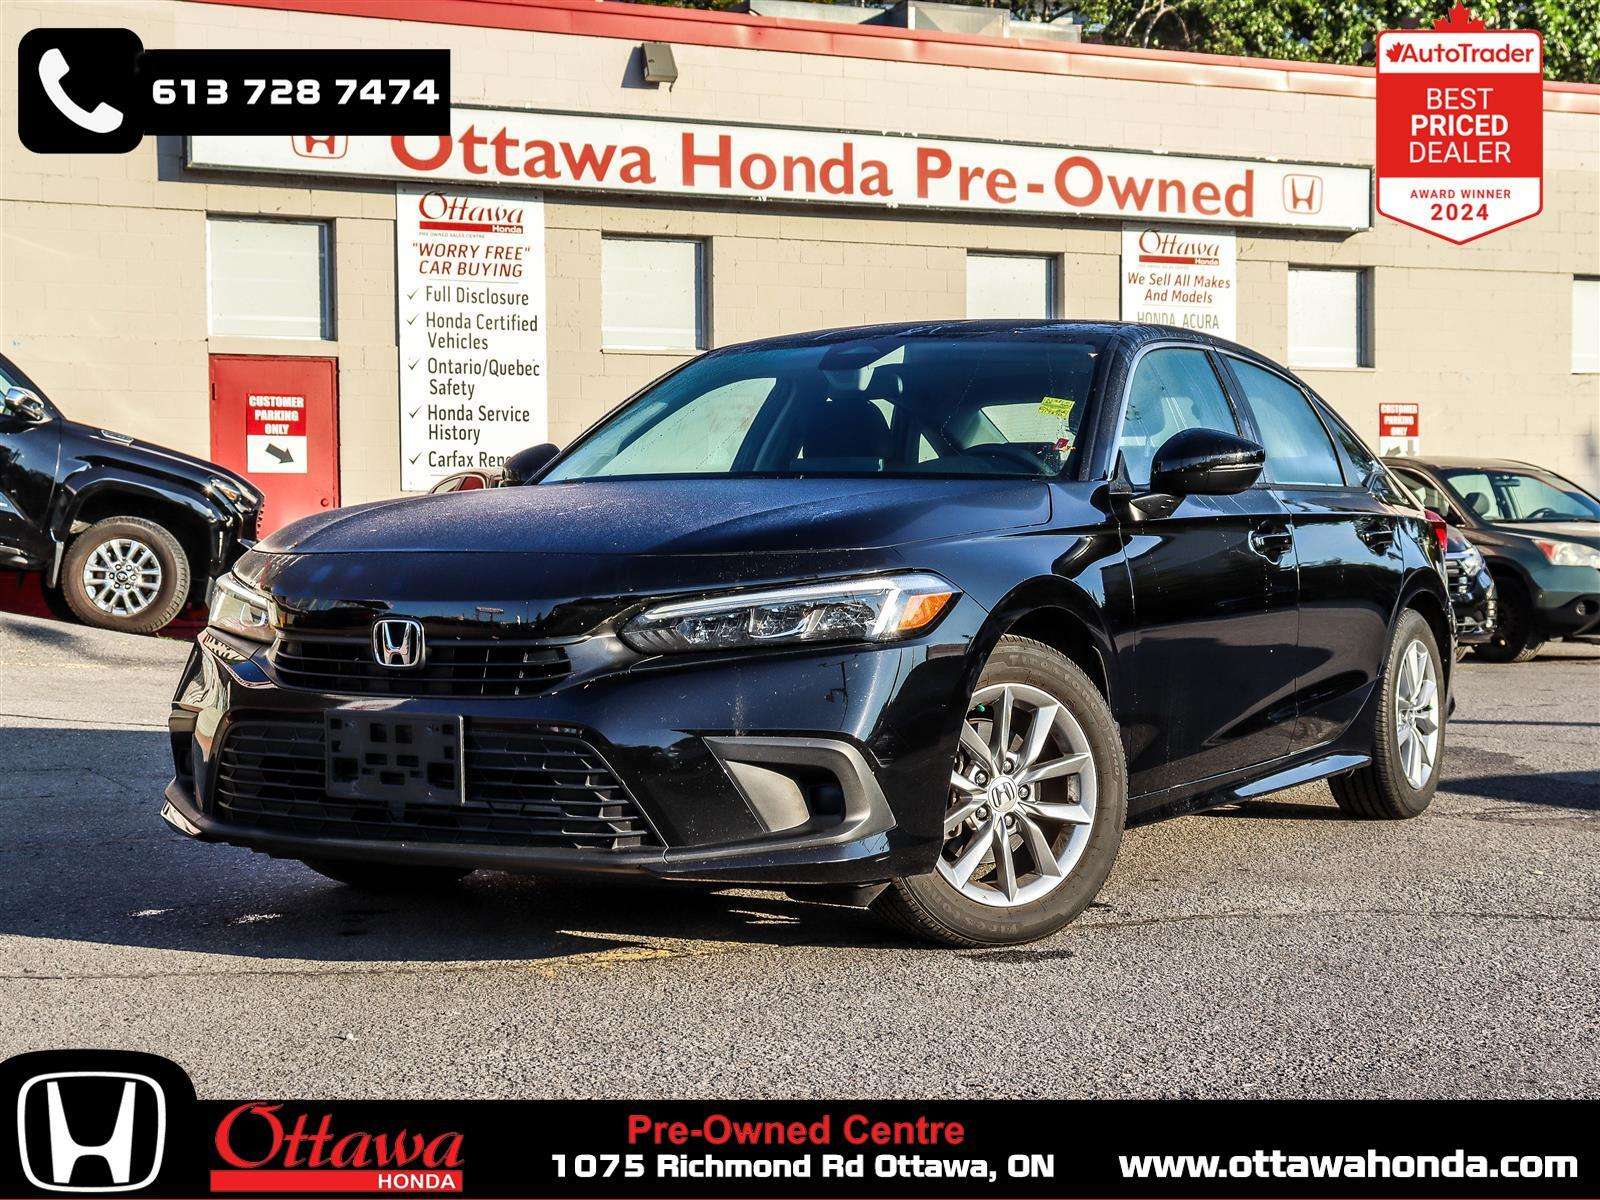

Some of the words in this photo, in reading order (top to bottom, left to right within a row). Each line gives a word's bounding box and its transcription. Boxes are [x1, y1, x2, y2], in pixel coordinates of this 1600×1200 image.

[390, 124, 657, 185] Ottawa
[681, 132, 893, 197] Honda
[916, 146, 1255, 218] Pre-Owned
[418, 190, 524, 224] Ottawa
[491, 224, 523, 234] Honda
[1139, 228, 1220, 256] Ottawa
[413, 242, 480, 259] "WORRY
[485, 246, 530, 261] FREE"
[419, 260, 451, 275] CAR
[457, 262, 523, 278] BUYING
[1128, 272, 1145, 285] We
[1149, 273, 1171, 286] Sell
[1174, 273, 1191, 287] All
[1194, 275, 1231, 288] Makes
[426, 286, 451, 302] Full
[456, 287, 529, 306] Disclosure
[1145, 288, 1168, 302] And
[1171, 290, 1213, 303] Models
[426, 312, 471, 329] Honda
[476, 314, 538, 332] Certified
[1137, 312, 1175, 326] HONDA
[1183, 313, 1219, 329] ACURA
[428, 332, 489, 350] Vehicles
[427, 357, 540, 377] Ontario/Quebec
[429, 379, 475, 400] Safety
[248, 395, 304, 408] CUSTOMER
[254, 409, 299, 421] PARKING
[428, 404, 473, 421] Honda
[478, 405, 530, 422] Service
[264, 423, 289, 435] ONLY
[429, 424, 481, 445] History
[428, 451, 474, 467] Carfax
